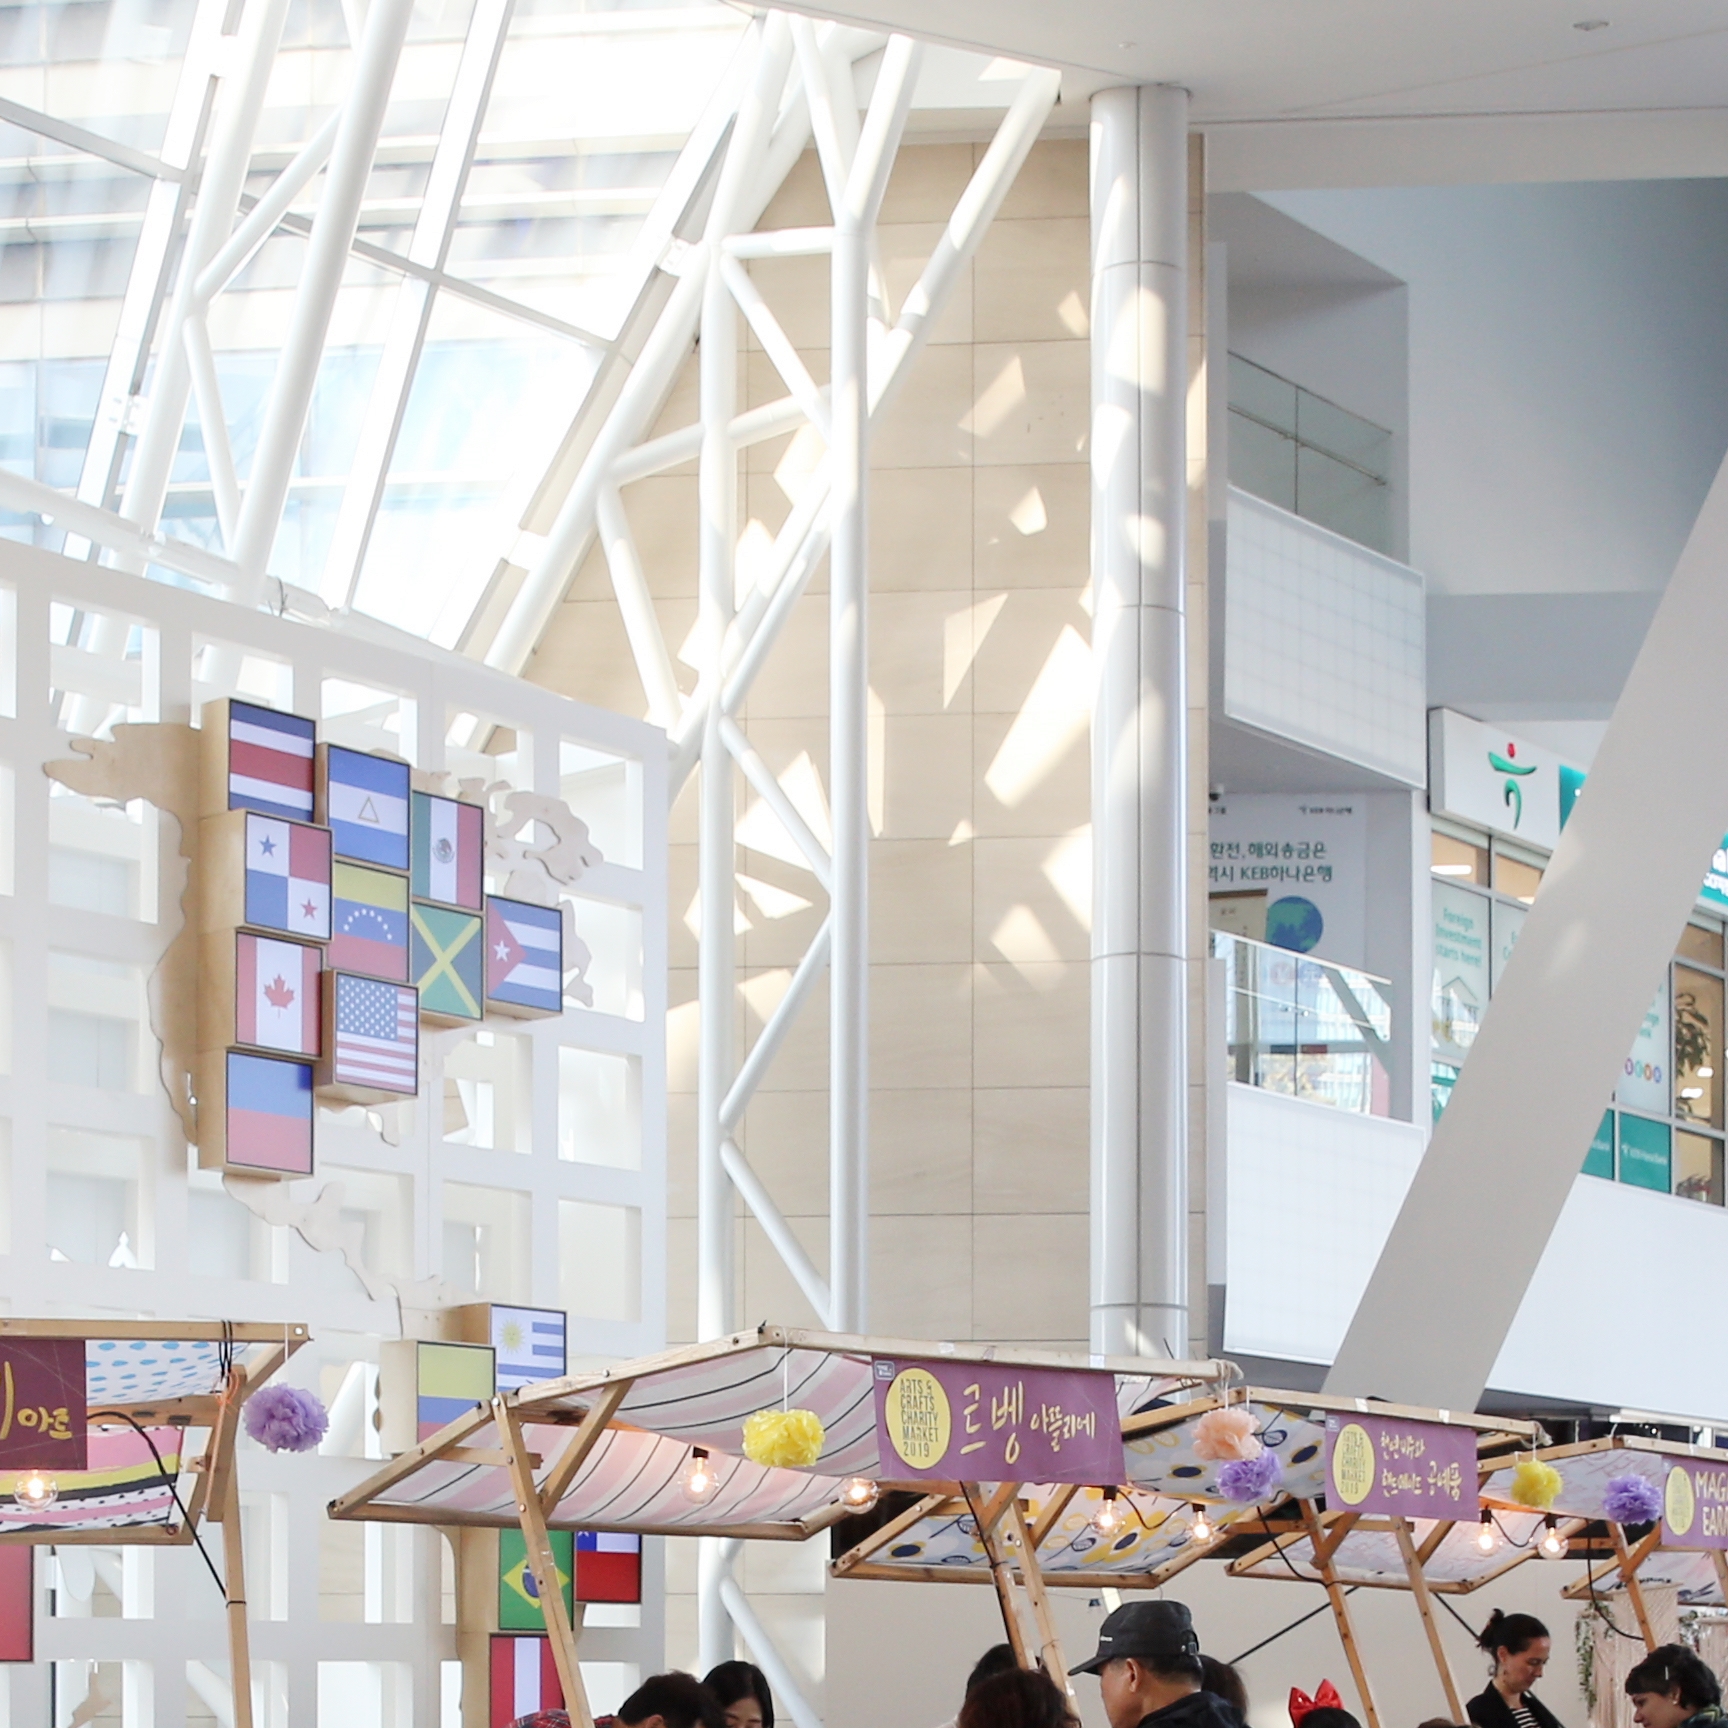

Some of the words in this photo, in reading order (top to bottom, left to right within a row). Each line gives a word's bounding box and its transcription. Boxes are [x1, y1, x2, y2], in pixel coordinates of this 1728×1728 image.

[899, 1378, 923, 1395] ARTS
[900, 1393, 936, 1411] CRAFTS
[901, 1409, 939, 1427] CHARITY
[902, 1425, 939, 1443] MARKET
[1030, 1402, 1096, 1453] 아뜰리에
[903, 1441, 931, 1458] 2019
